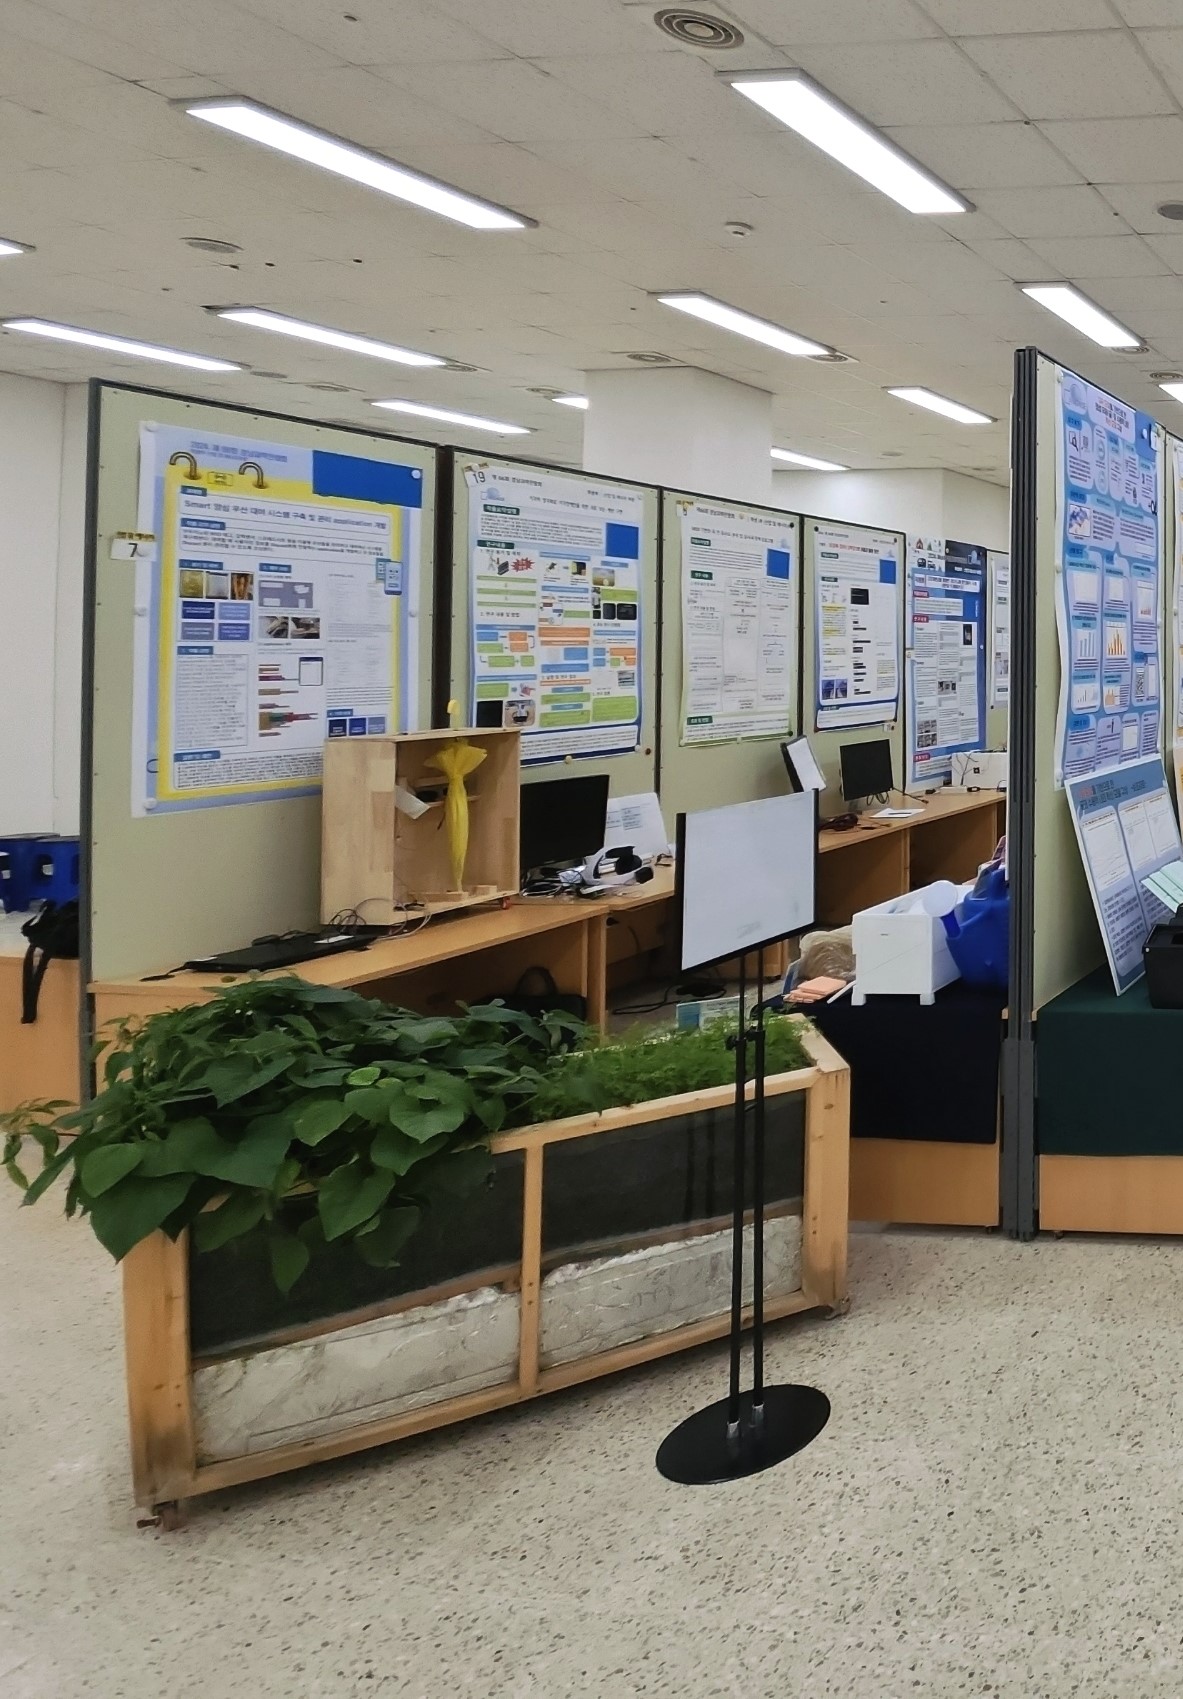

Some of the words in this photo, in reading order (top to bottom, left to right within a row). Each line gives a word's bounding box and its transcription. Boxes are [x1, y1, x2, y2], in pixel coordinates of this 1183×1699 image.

[472, 471, 486, 484] 19
[184, 500, 211, 509] Smart
[128, 542, 138, 557] 7
